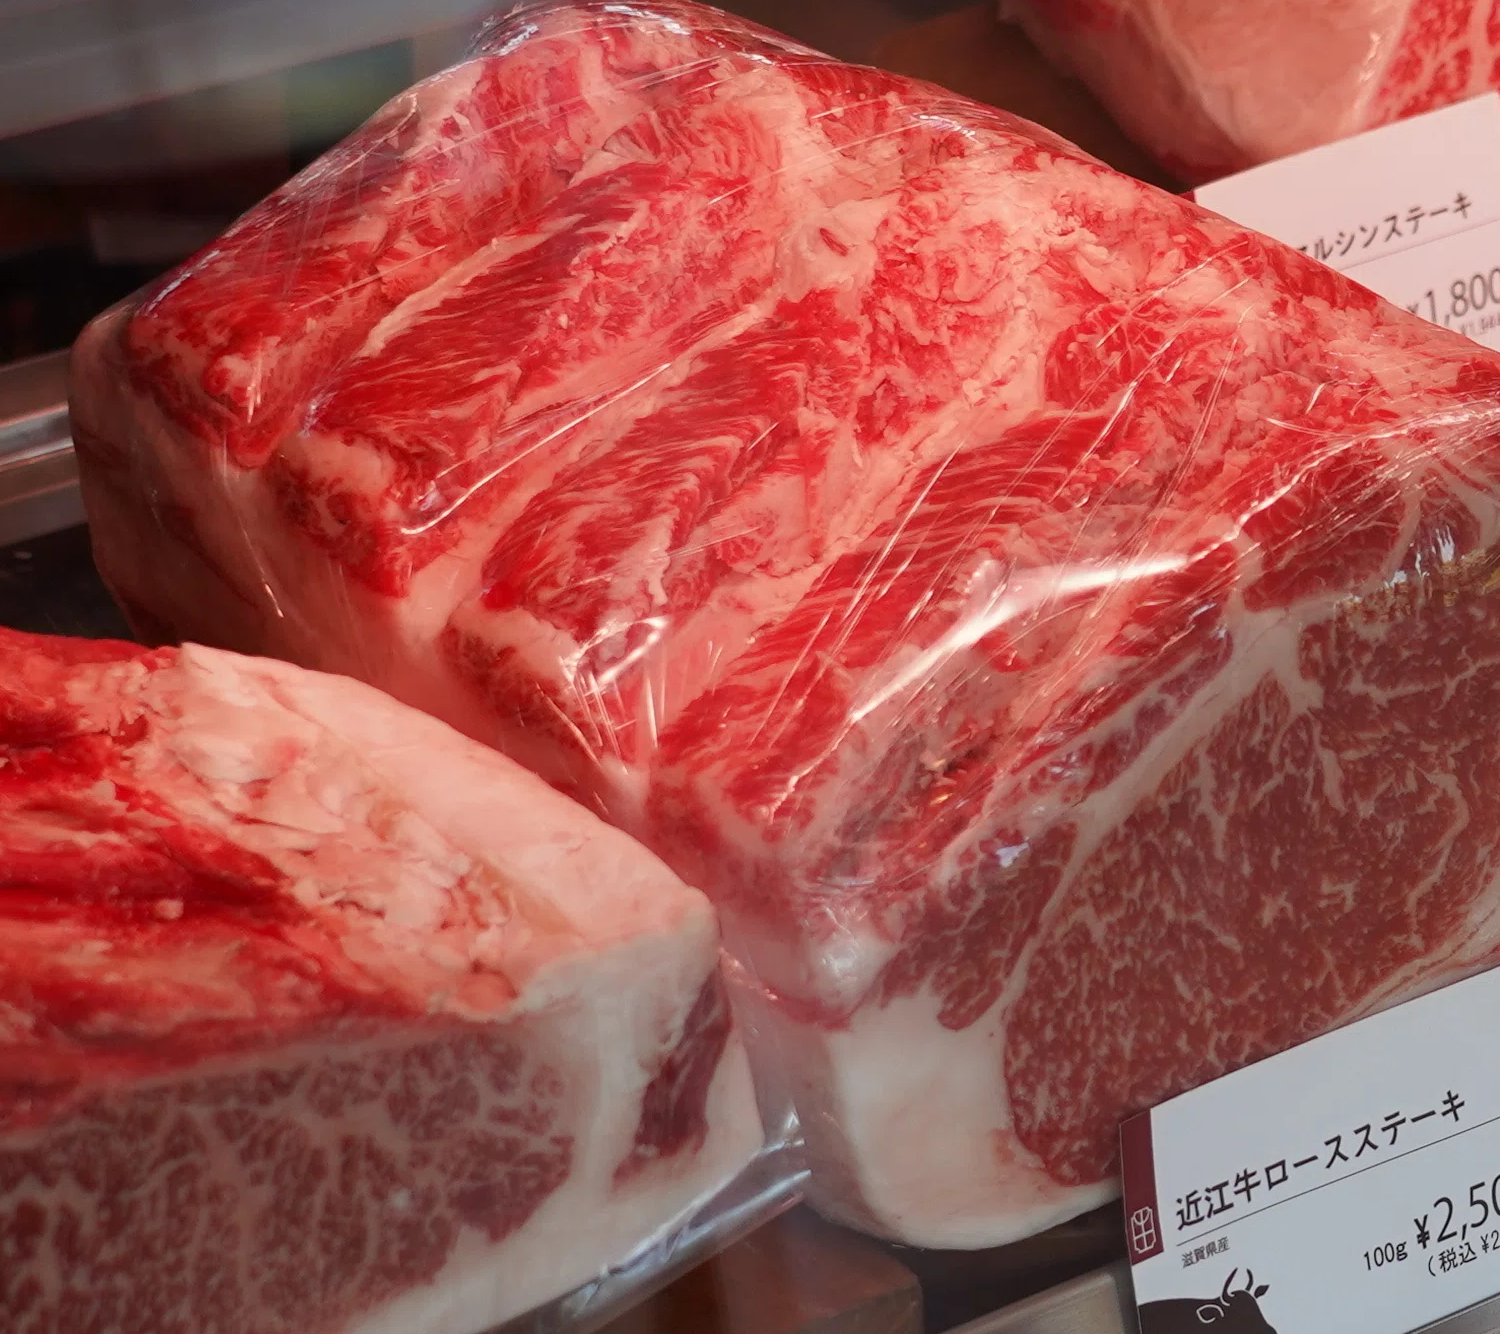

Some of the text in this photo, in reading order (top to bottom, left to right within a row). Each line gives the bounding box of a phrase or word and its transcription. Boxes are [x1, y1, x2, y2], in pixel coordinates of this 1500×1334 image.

[1176, 1089, 1466, 1230] 近江牛ロースステーキ
[1181, 1235, 1230, 1268] 滋賀県産
[1364, 1242, 1408, 1270] 100g
[1427, 1242, 1477, 1276] (税込
